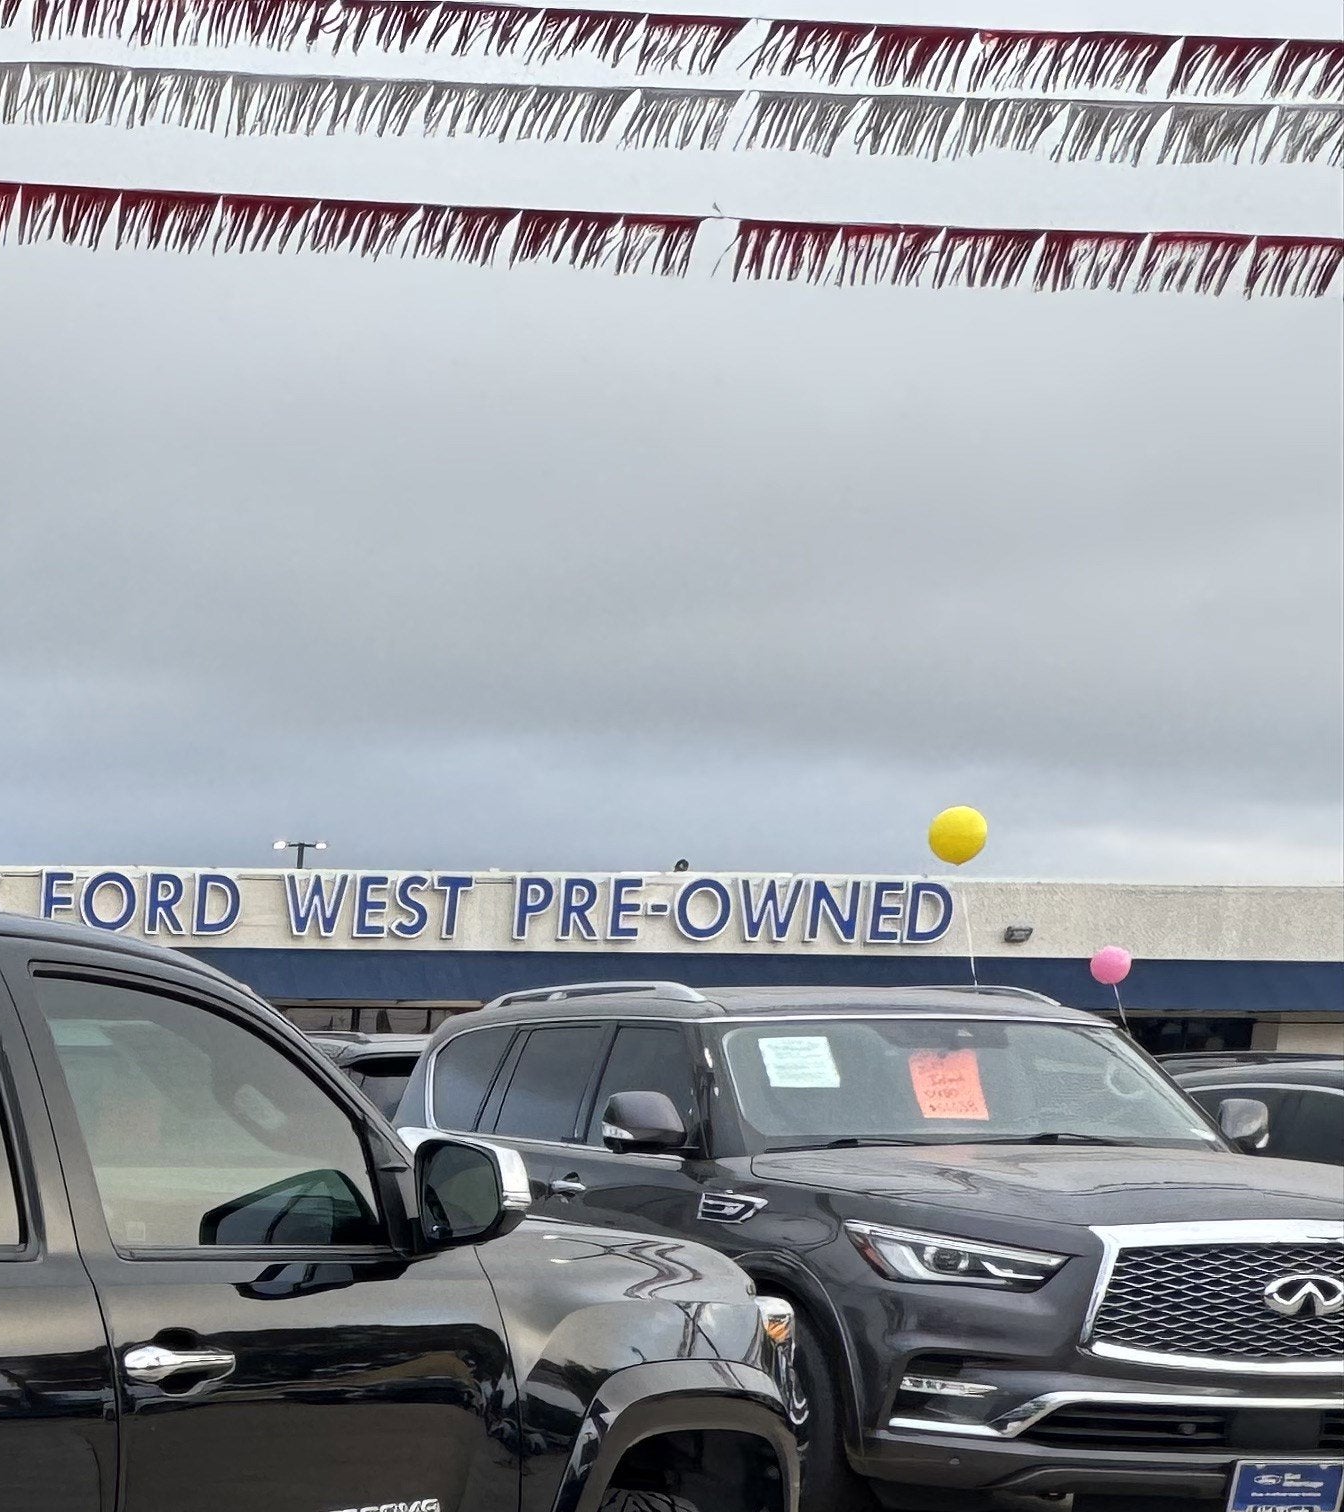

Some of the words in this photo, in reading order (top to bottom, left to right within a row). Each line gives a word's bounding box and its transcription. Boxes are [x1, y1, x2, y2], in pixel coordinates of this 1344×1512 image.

[40, 871, 241, 934] FORD
[286, 873, 473, 938] WEST
[512, 876, 954, 945] PRE-OWNED
